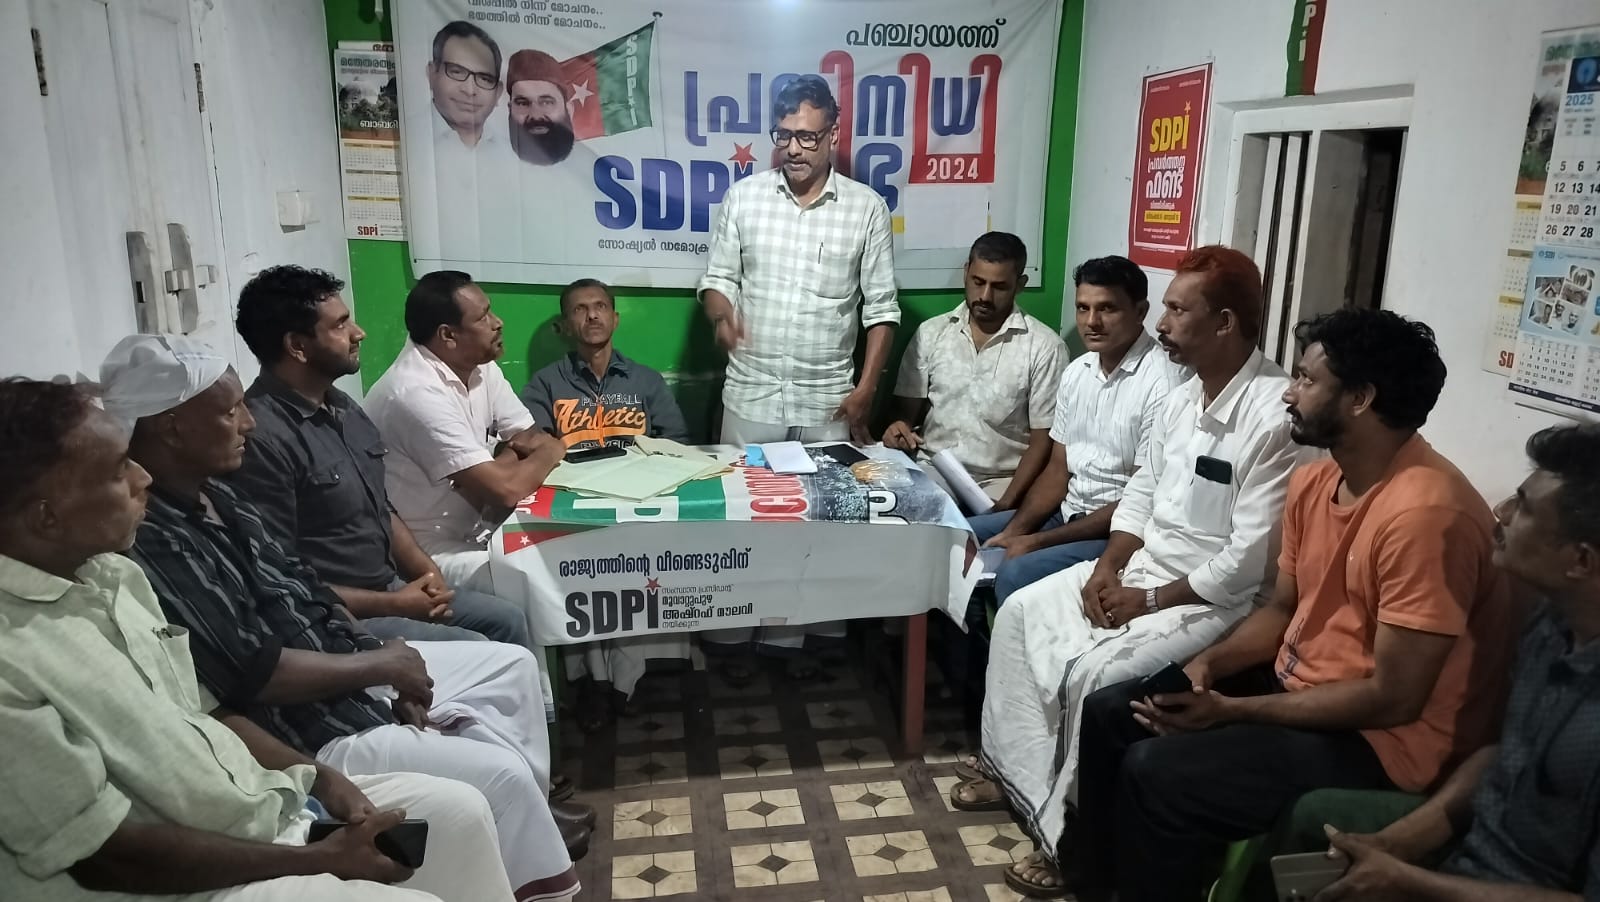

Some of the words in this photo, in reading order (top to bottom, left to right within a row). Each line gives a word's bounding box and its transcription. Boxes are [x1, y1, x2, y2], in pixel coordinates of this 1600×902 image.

[846, 18, 1006, 48] പഞ്ചായത്ത്
[1298, 3, 1317, 61] PI
[1565, 94, 1594, 107] 2025
[928, 158, 979, 181] 2024
[1577, 161, 1584, 171] 6
[594, 155, 753, 233] SDP
[1554, 182, 1565, 193] 12
[1572, 183, 1583, 194] 13
[1551, 204, 1561, 214] 19
[1584, 205, 1597, 216] 21
[1546, 224, 1557, 235] 26
[1562, 225, 1575, 237] 27
[1580, 227, 1593, 238] 28
[1499, 350, 1515, 369] SD
[559, 553, 650, 578] രാജ്യത്തിന്റെ
[657, 547, 751, 573] വീണ്ടെടുപ്പിന്
